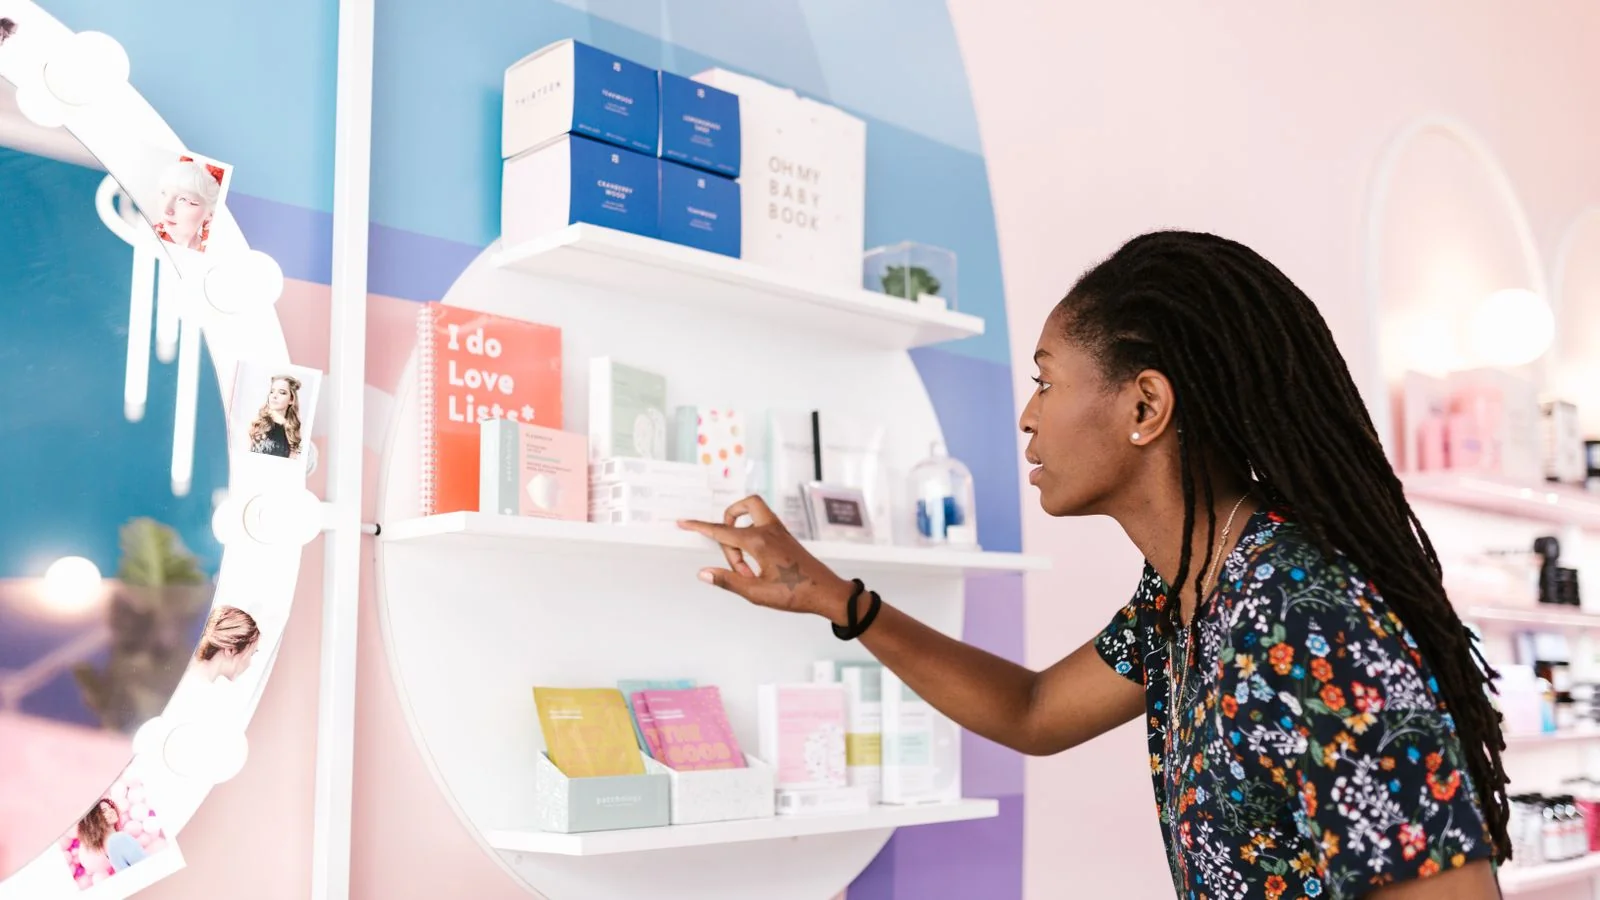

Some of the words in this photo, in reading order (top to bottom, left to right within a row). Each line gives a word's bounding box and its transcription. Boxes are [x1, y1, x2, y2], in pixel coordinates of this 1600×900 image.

[768, 155, 794, 178] OH
[797, 164, 822, 186] MY
[768, 178, 823, 208] BABY
[768, 201, 820, 232] BOOK
[447, 323, 460, 351] I
[465, 327, 502, 358] do
[448, 359, 515, 395] Love
